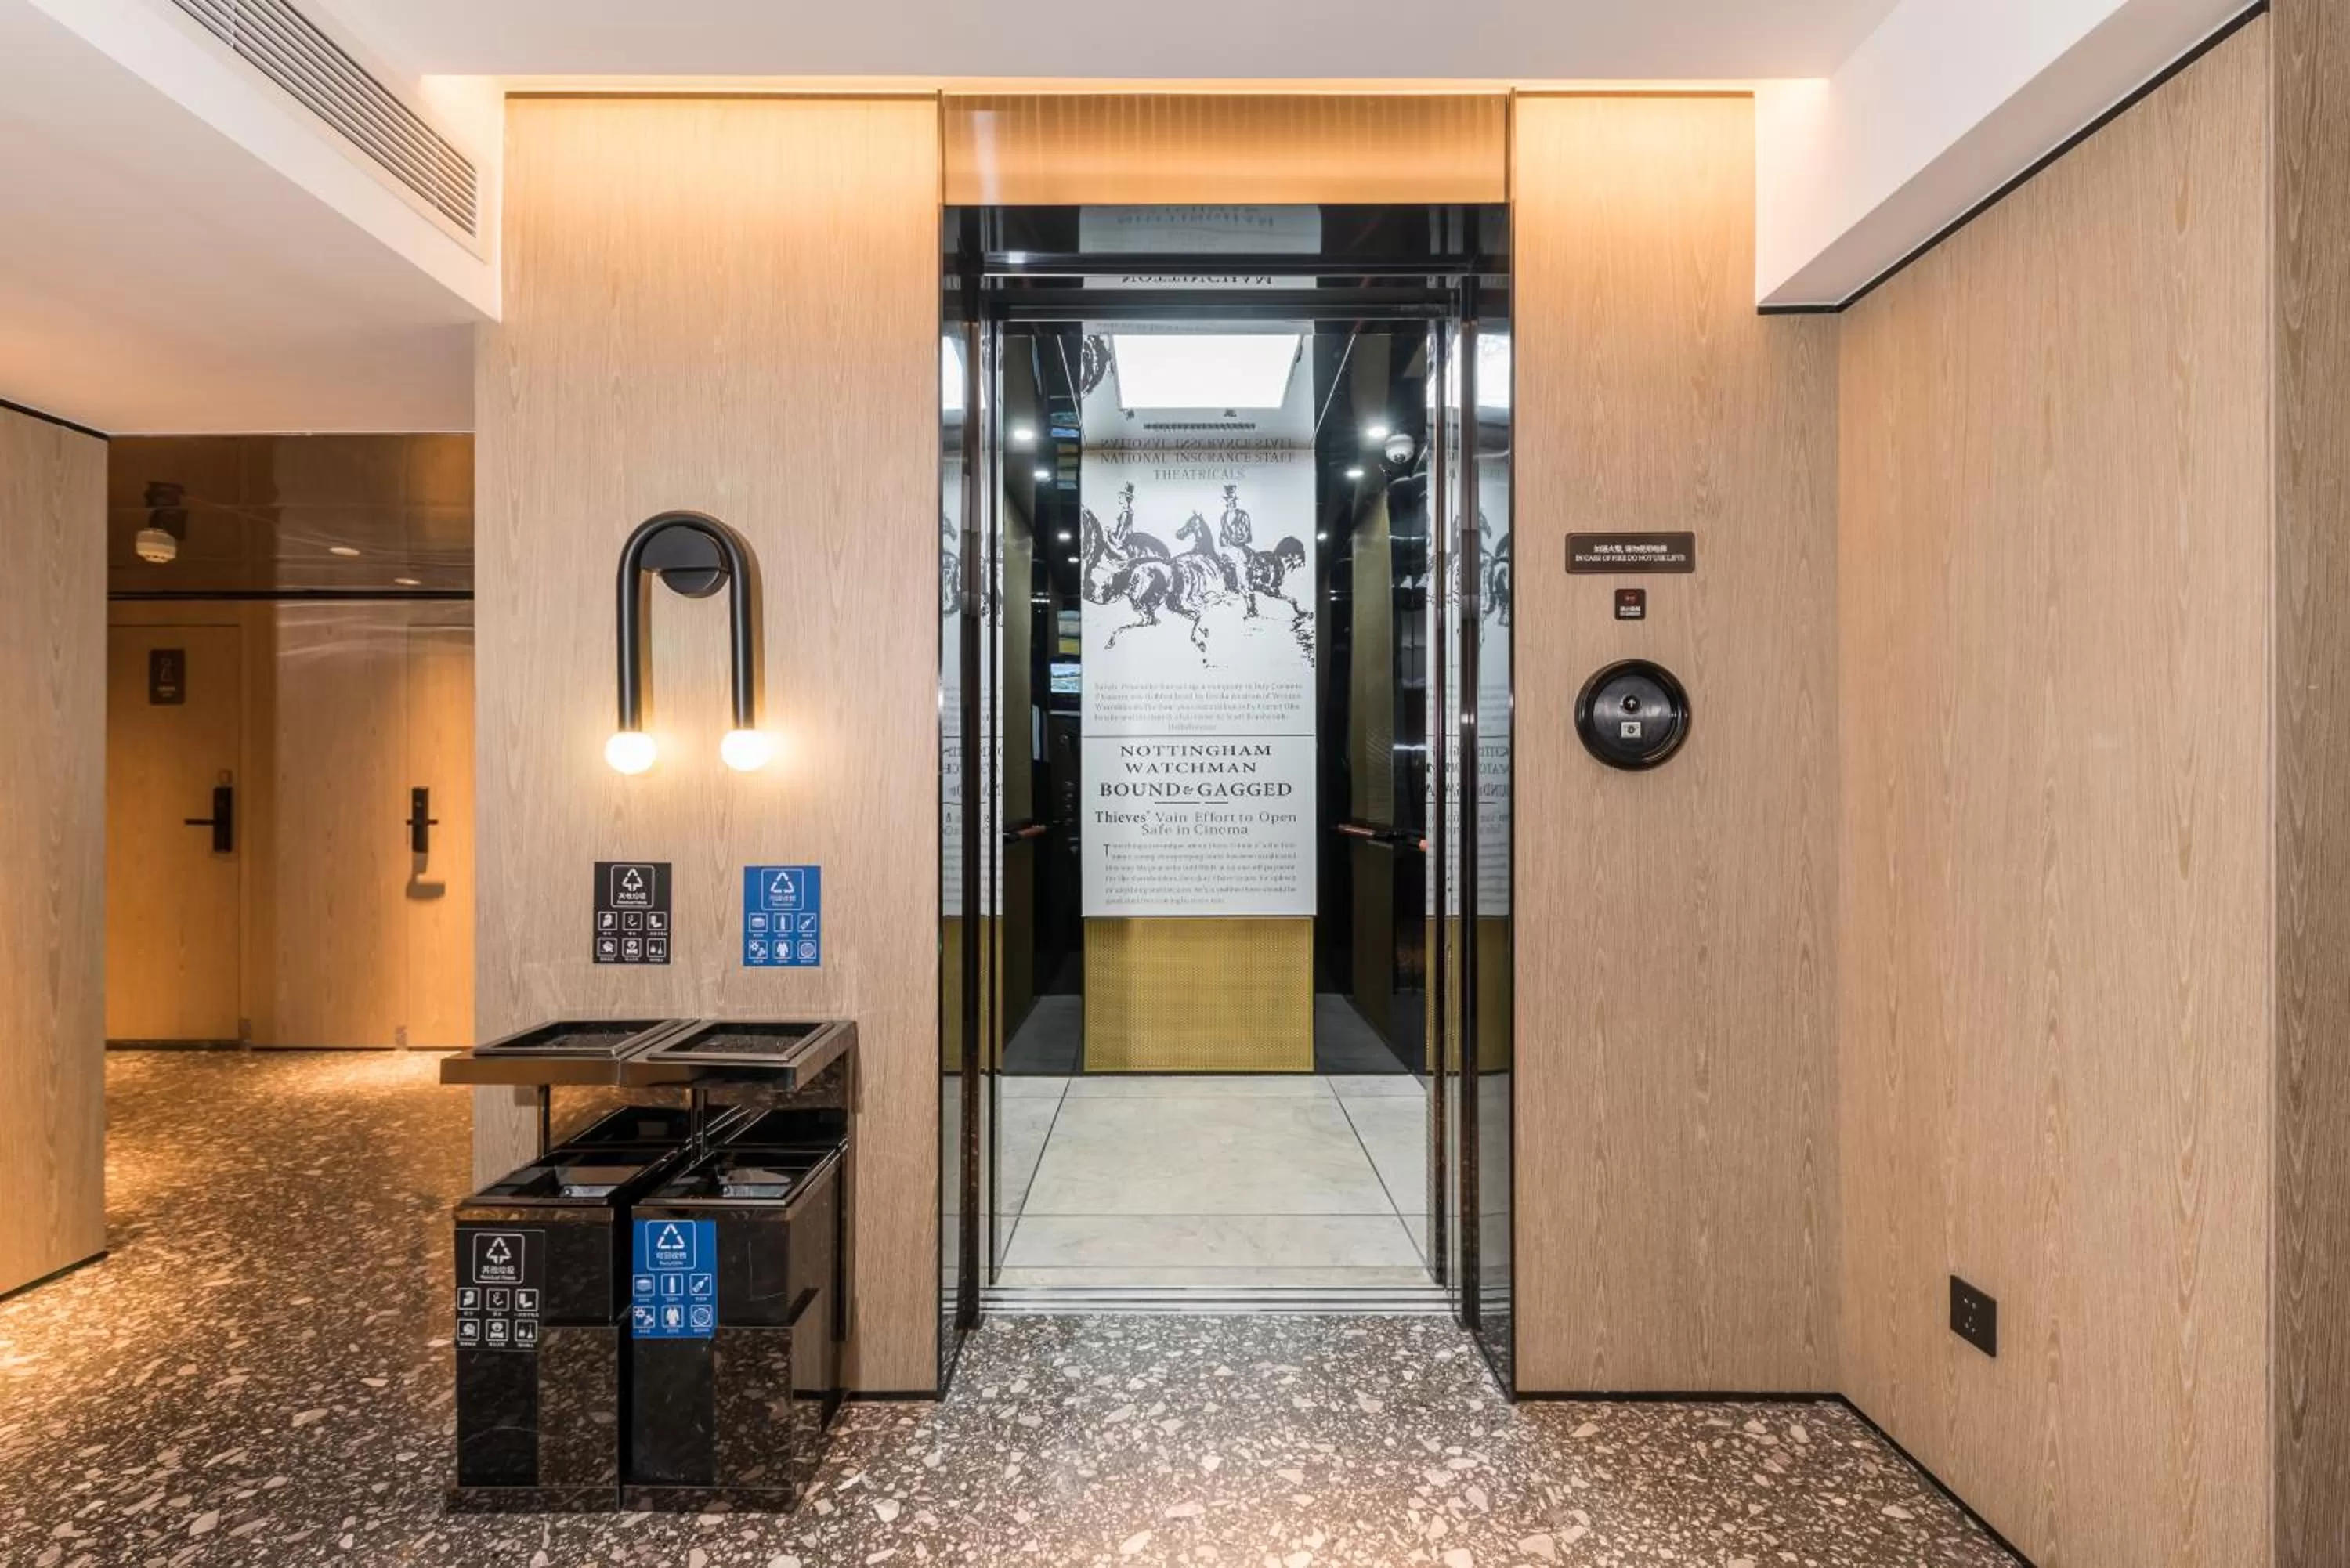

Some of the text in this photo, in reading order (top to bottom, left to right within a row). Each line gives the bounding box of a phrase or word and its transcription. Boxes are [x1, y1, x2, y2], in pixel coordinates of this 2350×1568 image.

[1100, 453, 1166, 464] NATIONAL
[1152, 469, 1246, 481] THEATRICALS
[1120, 745, 1272, 757] NOTTINGHAM
[1125, 762, 1256, 774] WATCHMAN
[1155, 811, 1188, 823] Vain
[1195, 811, 1235, 823] Effort
[1238, 813, 1253, 823] to
[1259, 811, 1296, 825] Open
[1141, 825, 1249, 836] Safe in Cinema
